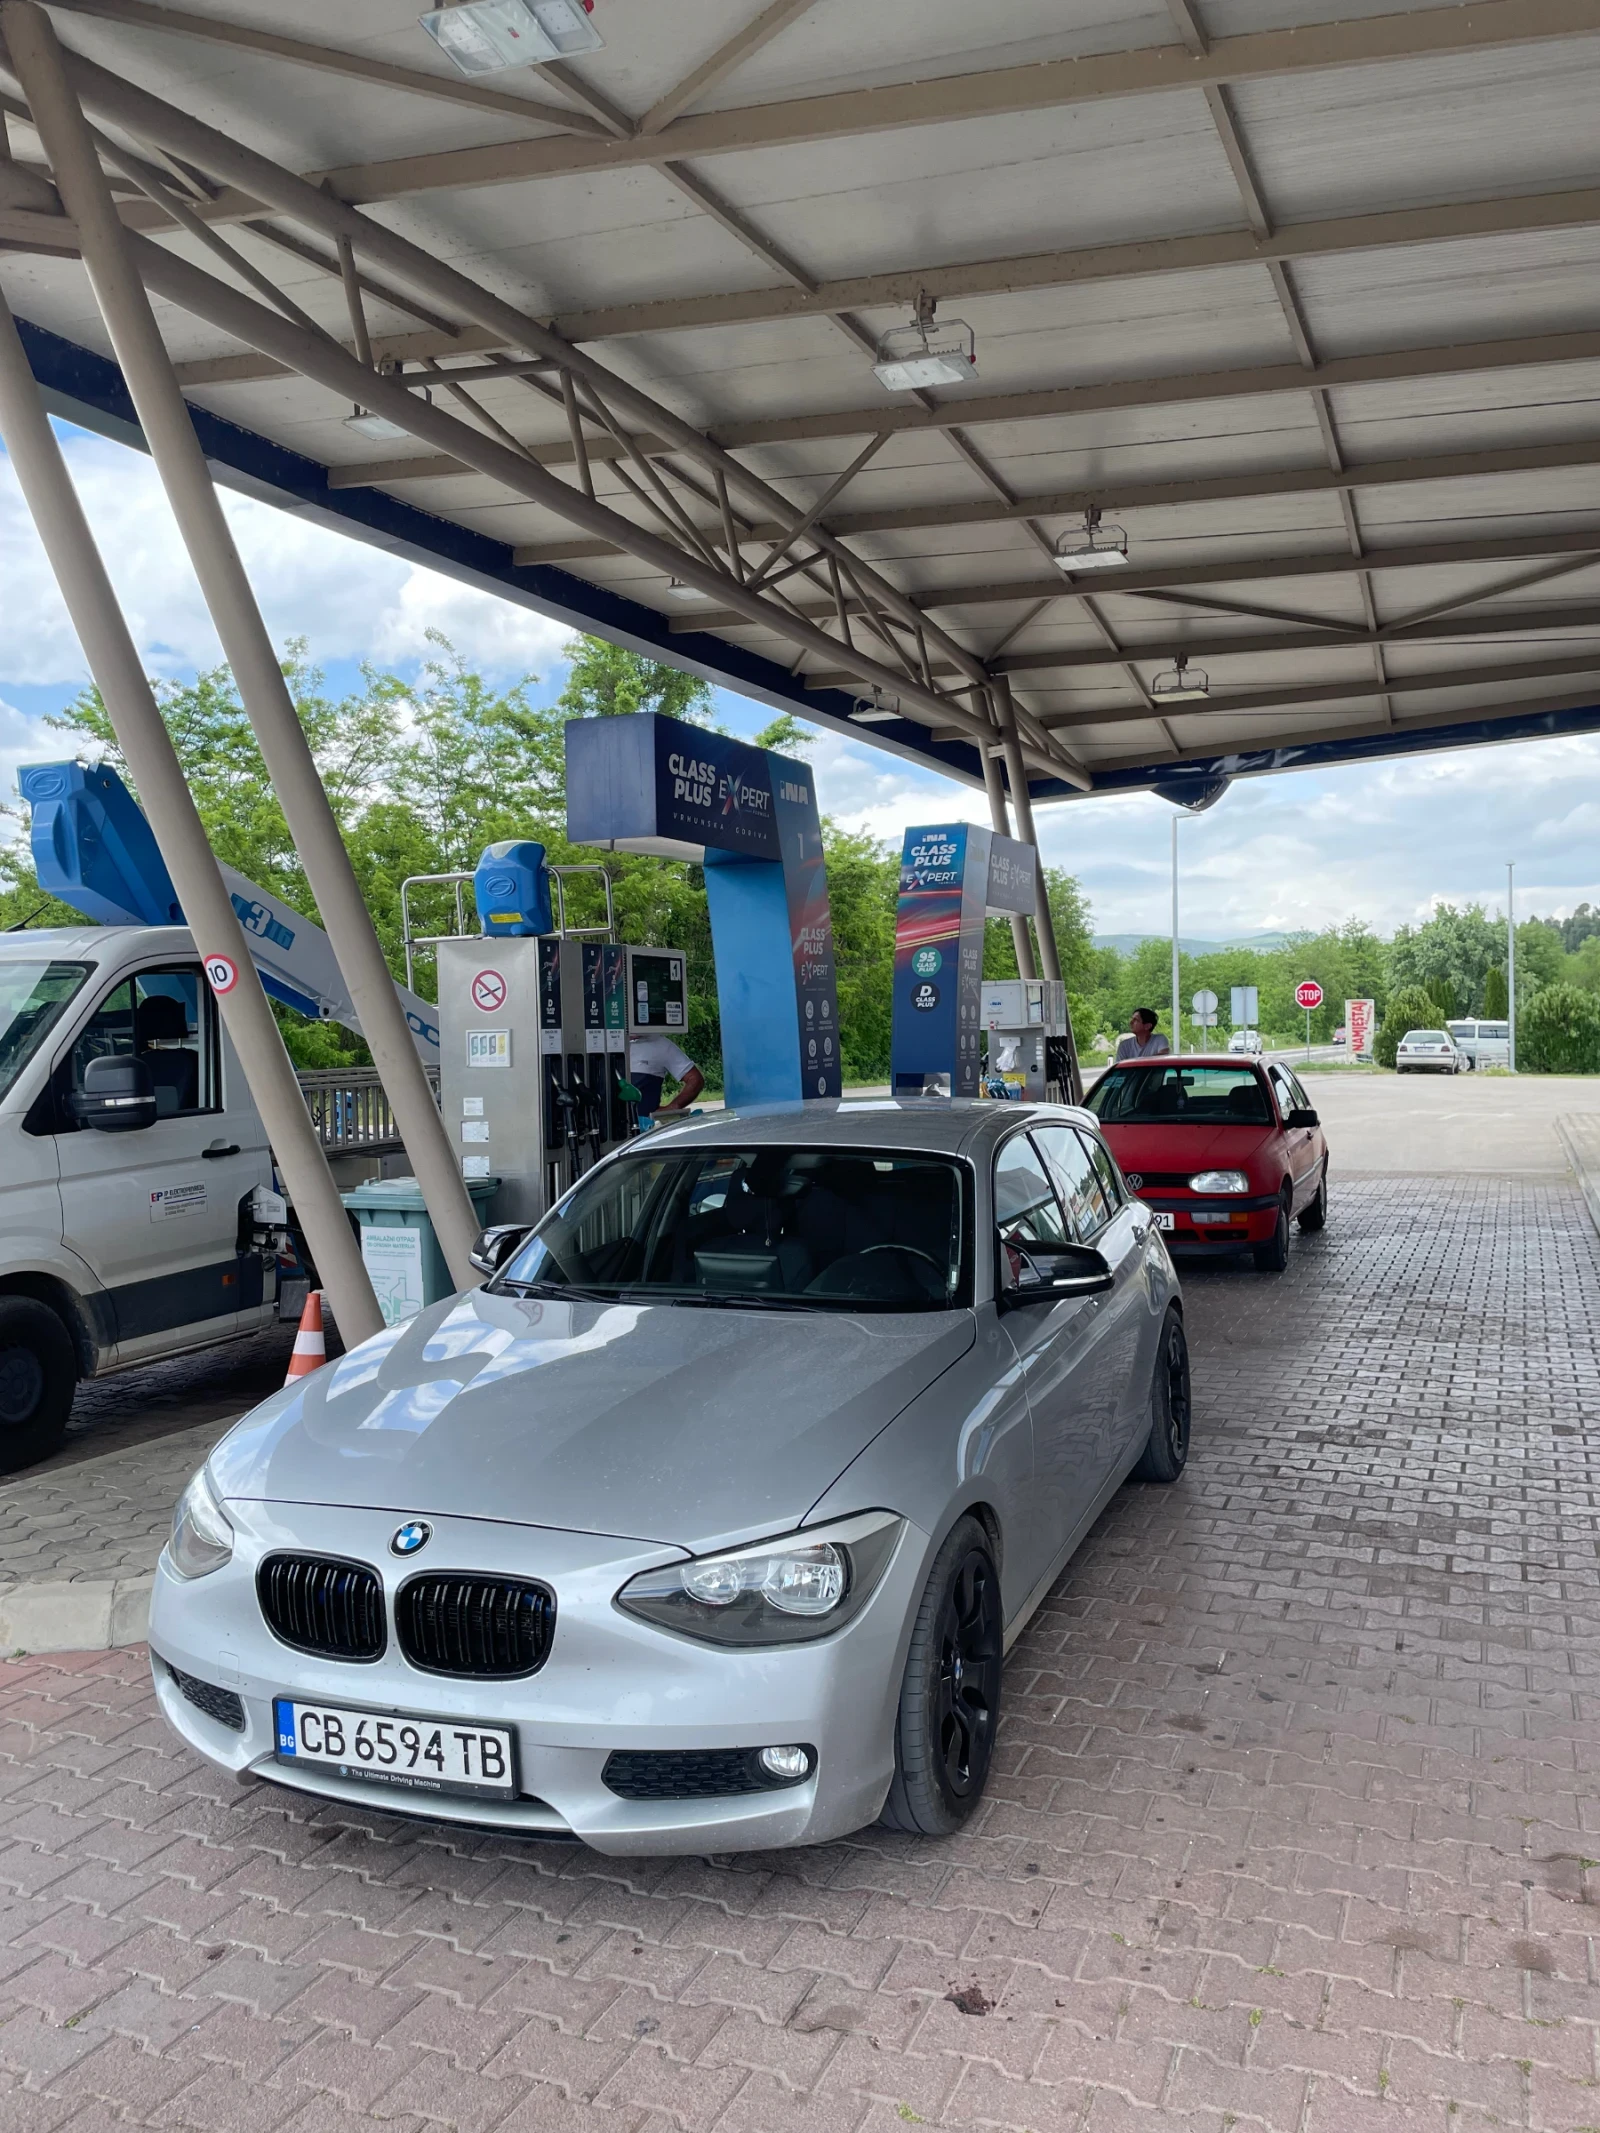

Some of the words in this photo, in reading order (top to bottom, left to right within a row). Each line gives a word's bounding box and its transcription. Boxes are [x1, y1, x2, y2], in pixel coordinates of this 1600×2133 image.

[668, 753, 716, 786] CLASS
[674, 778, 712, 807] PLUS
[673, 812, 725, 831] VRHUNSKA
[735, 826, 767, 840] GORIVA
[911, 843, 957, 857] CLASS
[914, 855, 952, 867] PLUS
[991, 854, 1010, 872] CLASS
[993, 869, 1008, 886] PLUS
[801, 927, 826, 942] CLASS
[803, 942, 824, 955] PLUS
[962, 948, 978, 960] CLASS
[919, 951, 936, 962] 95
[964, 959, 977, 971] PLUS
[208, 964, 227, 984] 10
[920, 985, 932, 997] D
[1298, 989, 1321, 1001] STOP
[151, 1191, 163, 1203] EP
[1154, 1214, 1171, 1228] 91
[279, 1734, 295, 1748] BG
[300, 1711, 346, 1757] CB
[355, 1719, 445, 1772] 6594
[453, 1732, 505, 1779] TB
[352, 1769, 362, 1777] The
[364, 1770, 389, 1781] Ultimate
[390, 1775, 412, 1786] Driving
[414, 1778, 441, 1789] Machine
